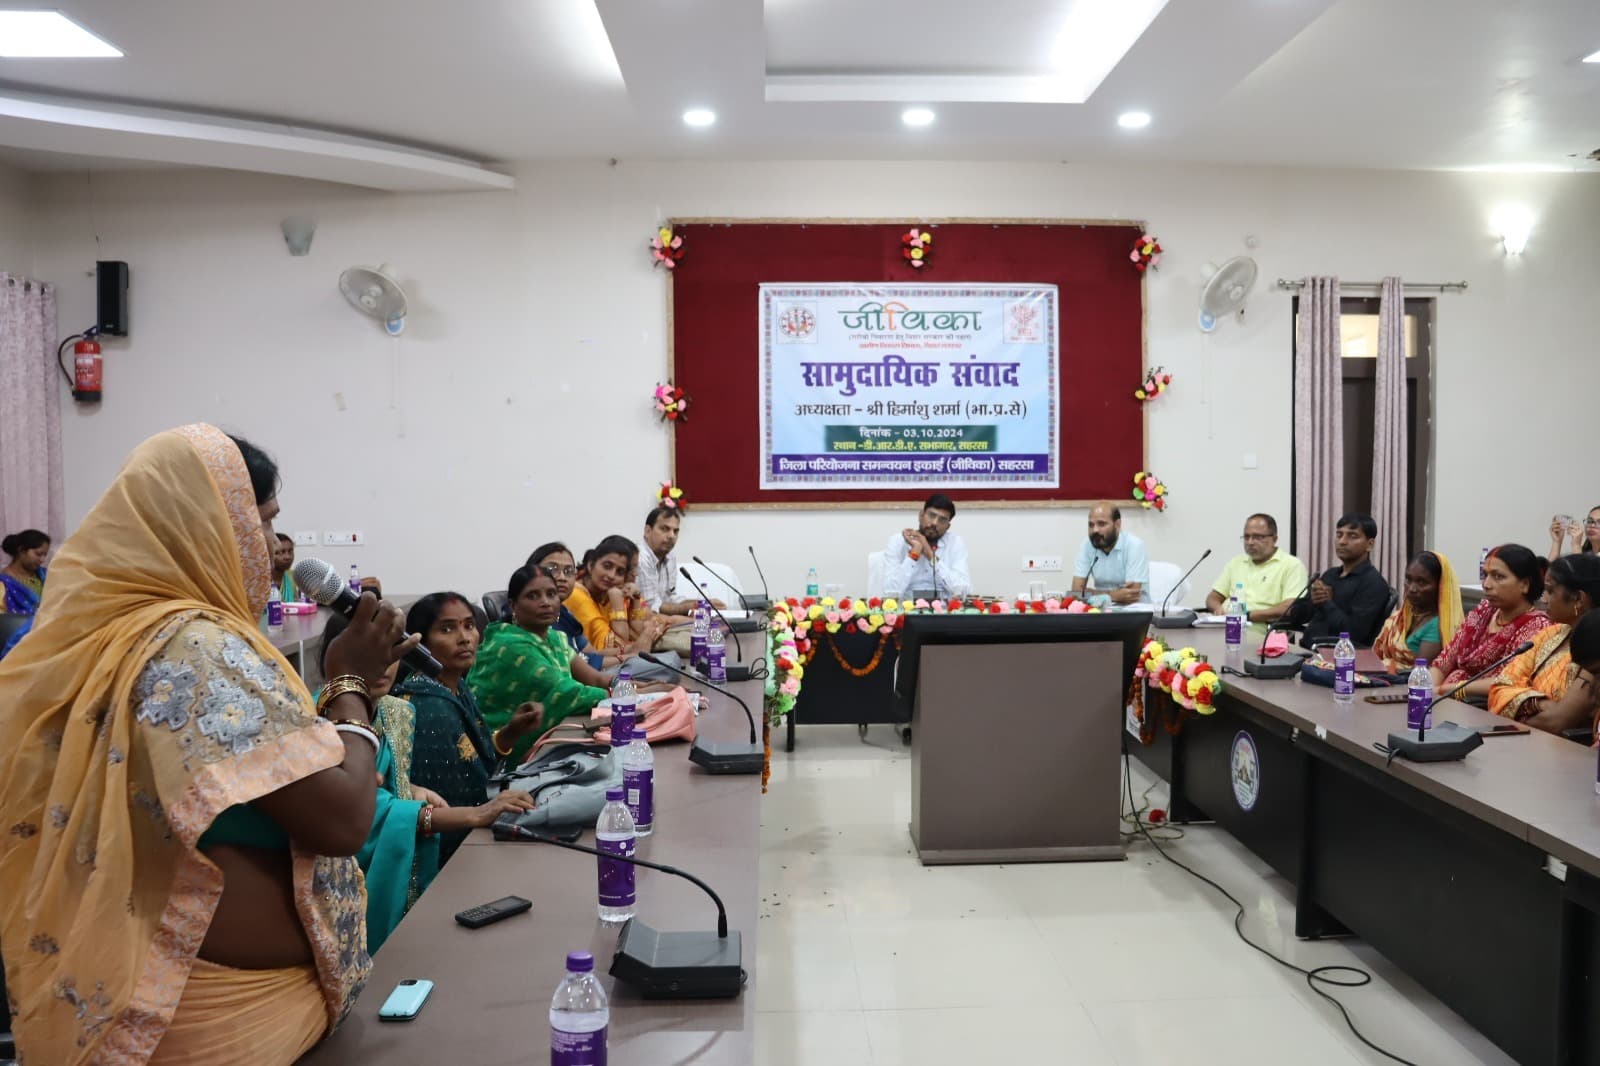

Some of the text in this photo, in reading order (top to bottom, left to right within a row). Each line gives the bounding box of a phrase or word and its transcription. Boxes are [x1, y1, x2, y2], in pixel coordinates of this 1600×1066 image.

[838, 301, 982, 331] जीविका
[800, 354, 1020, 396] सामुदायिक संवाद
[794, 401, 851, 416] अध्यक्षता
[867, 400, 883, 417] श्री
[887, 400, 931, 420] हिमांशु
[933, 400, 961, 416] शर्मा
[859, 427, 891, 438] दिनांक
[903, 428, 963, 438] 03.10.2024
[958, 441, 988, 450] सहरसा
[779, 457, 1035, 473] जिला परियोजना समन्वयन इकाई (जीविका) सहरसा
